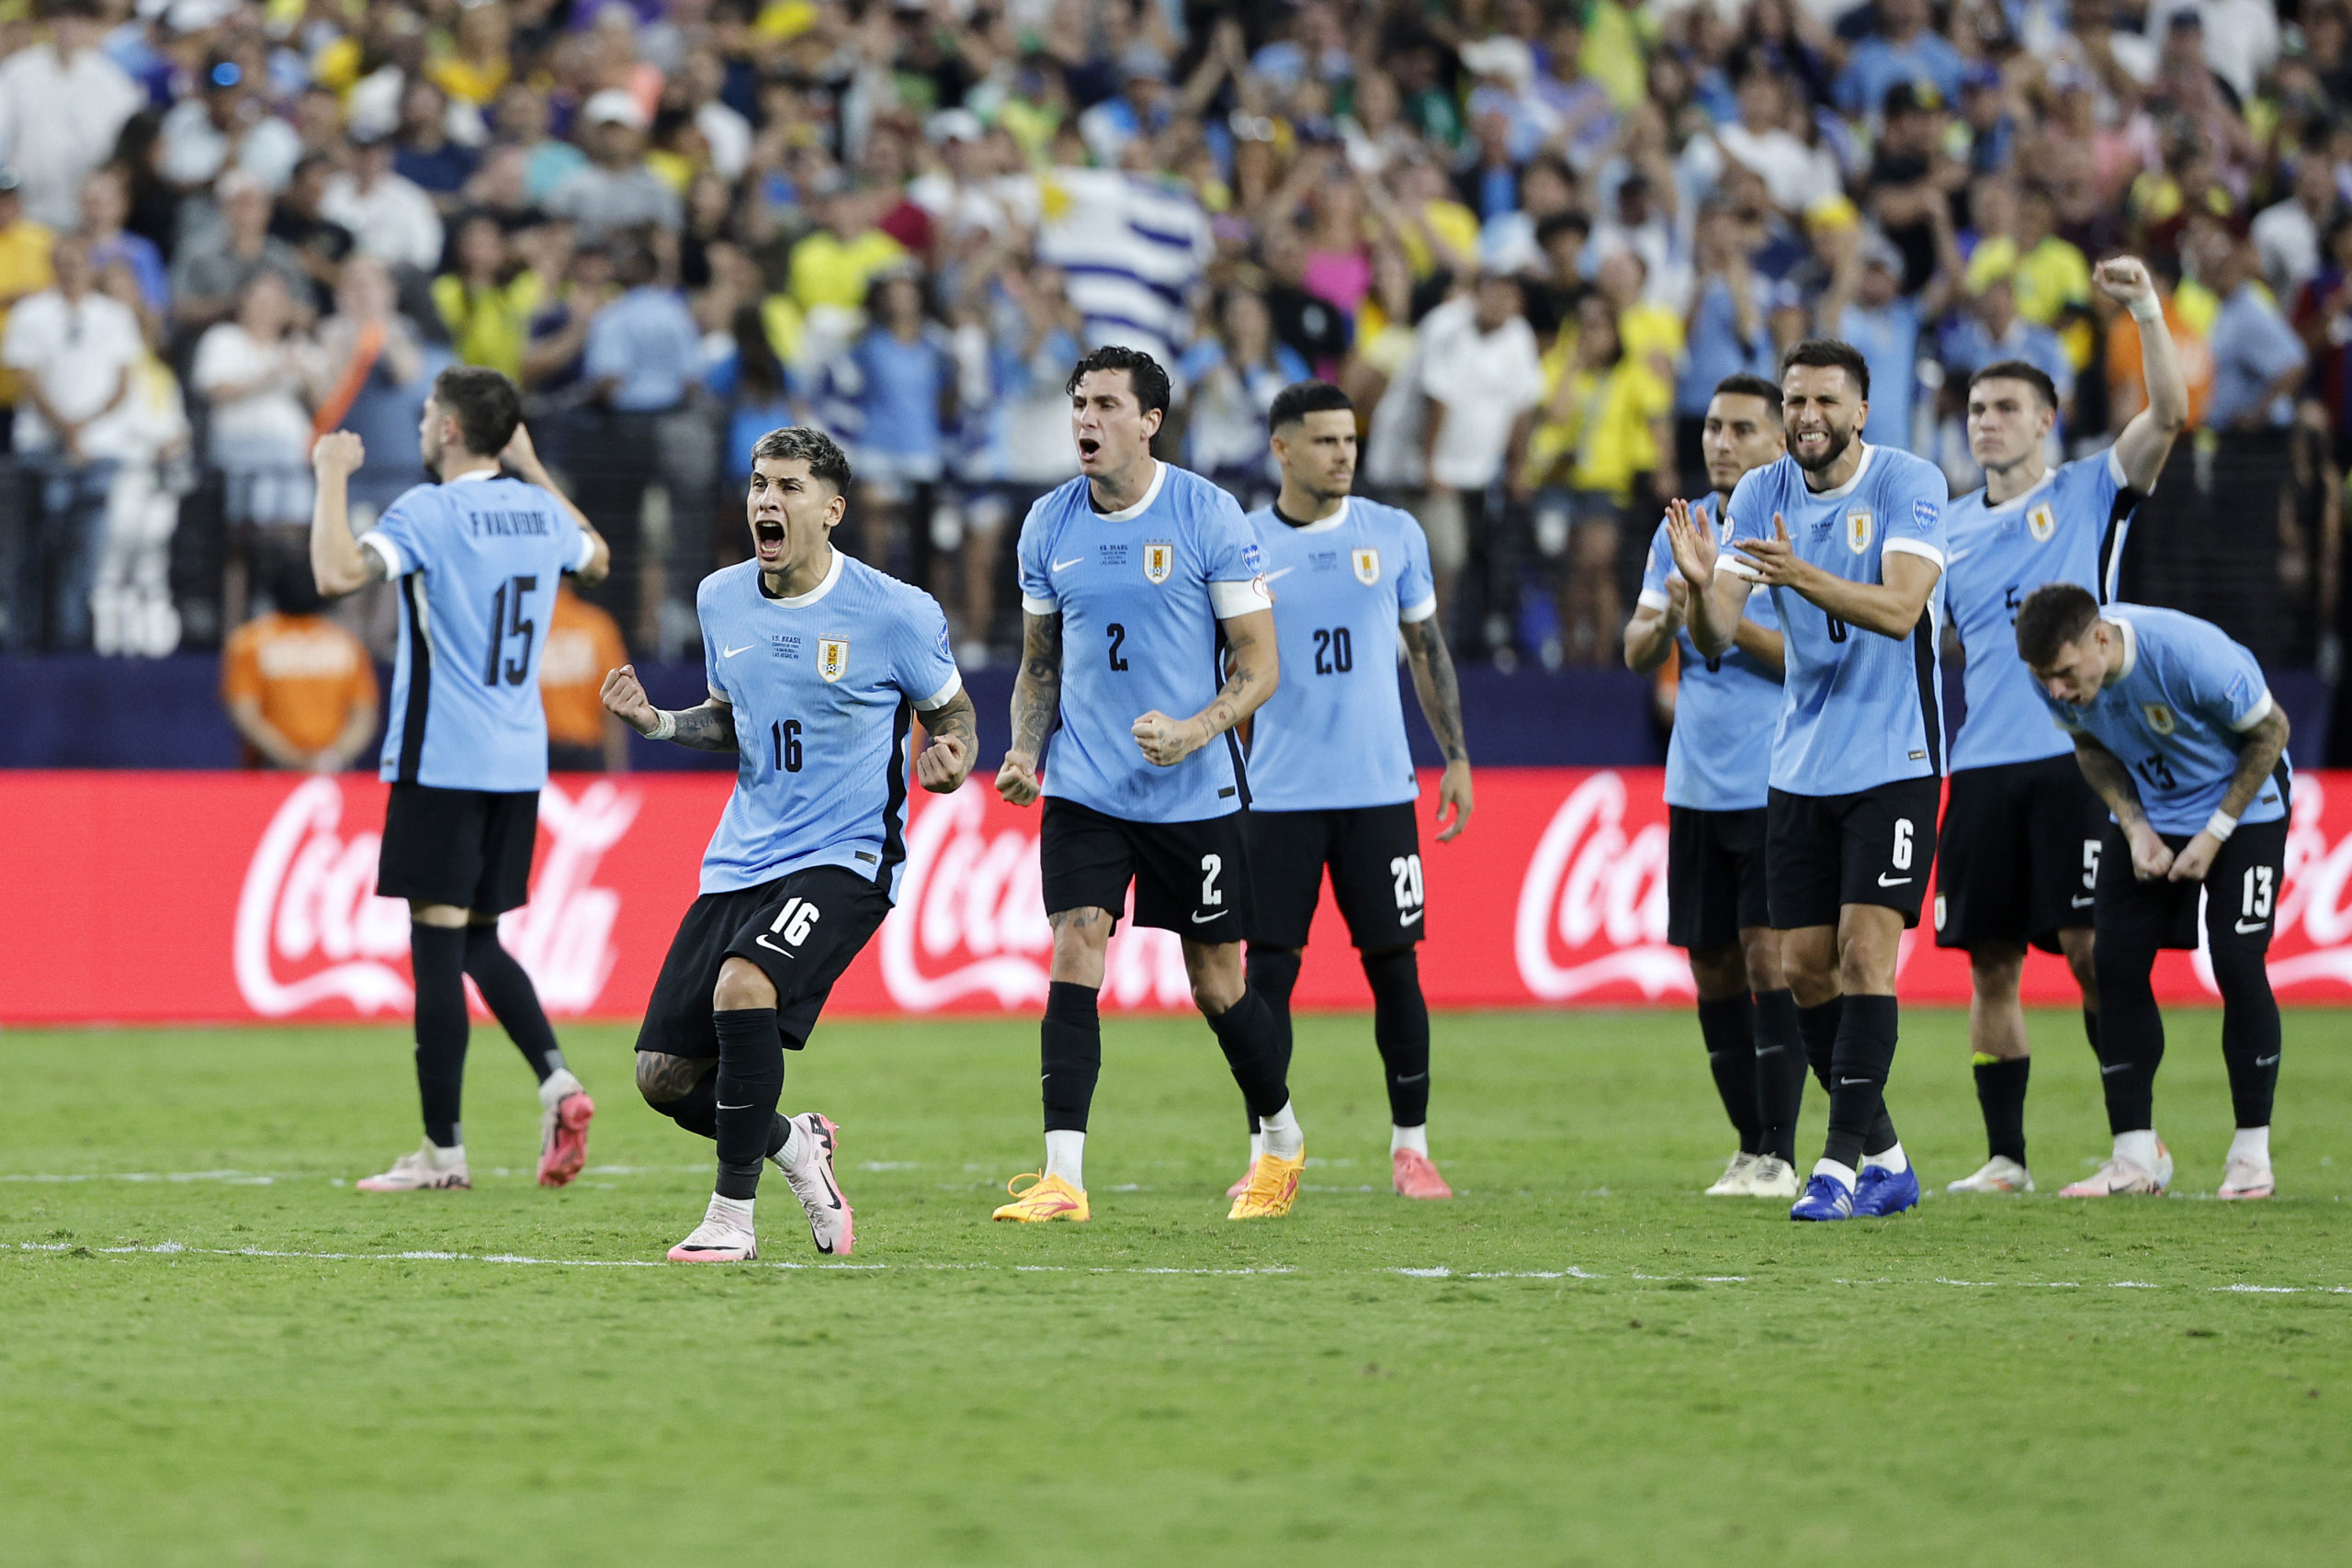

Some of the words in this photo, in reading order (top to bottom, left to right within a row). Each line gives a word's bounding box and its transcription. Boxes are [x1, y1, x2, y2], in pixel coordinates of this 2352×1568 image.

[484, 576, 537, 685] 15
[1107, 623, 1128, 671] 2
[1314, 628, 1352, 674] 20
[772, 719, 802, 773] 16
[2137, 754, 2177, 790] 13
[1893, 818, 1914, 871] 6
[2083, 840, 2102, 889] 5
[1202, 854, 1221, 905] 2
[1390, 854, 1424, 908] 20
[2242, 865, 2273, 919] 13
[770, 897, 820, 946] 16
